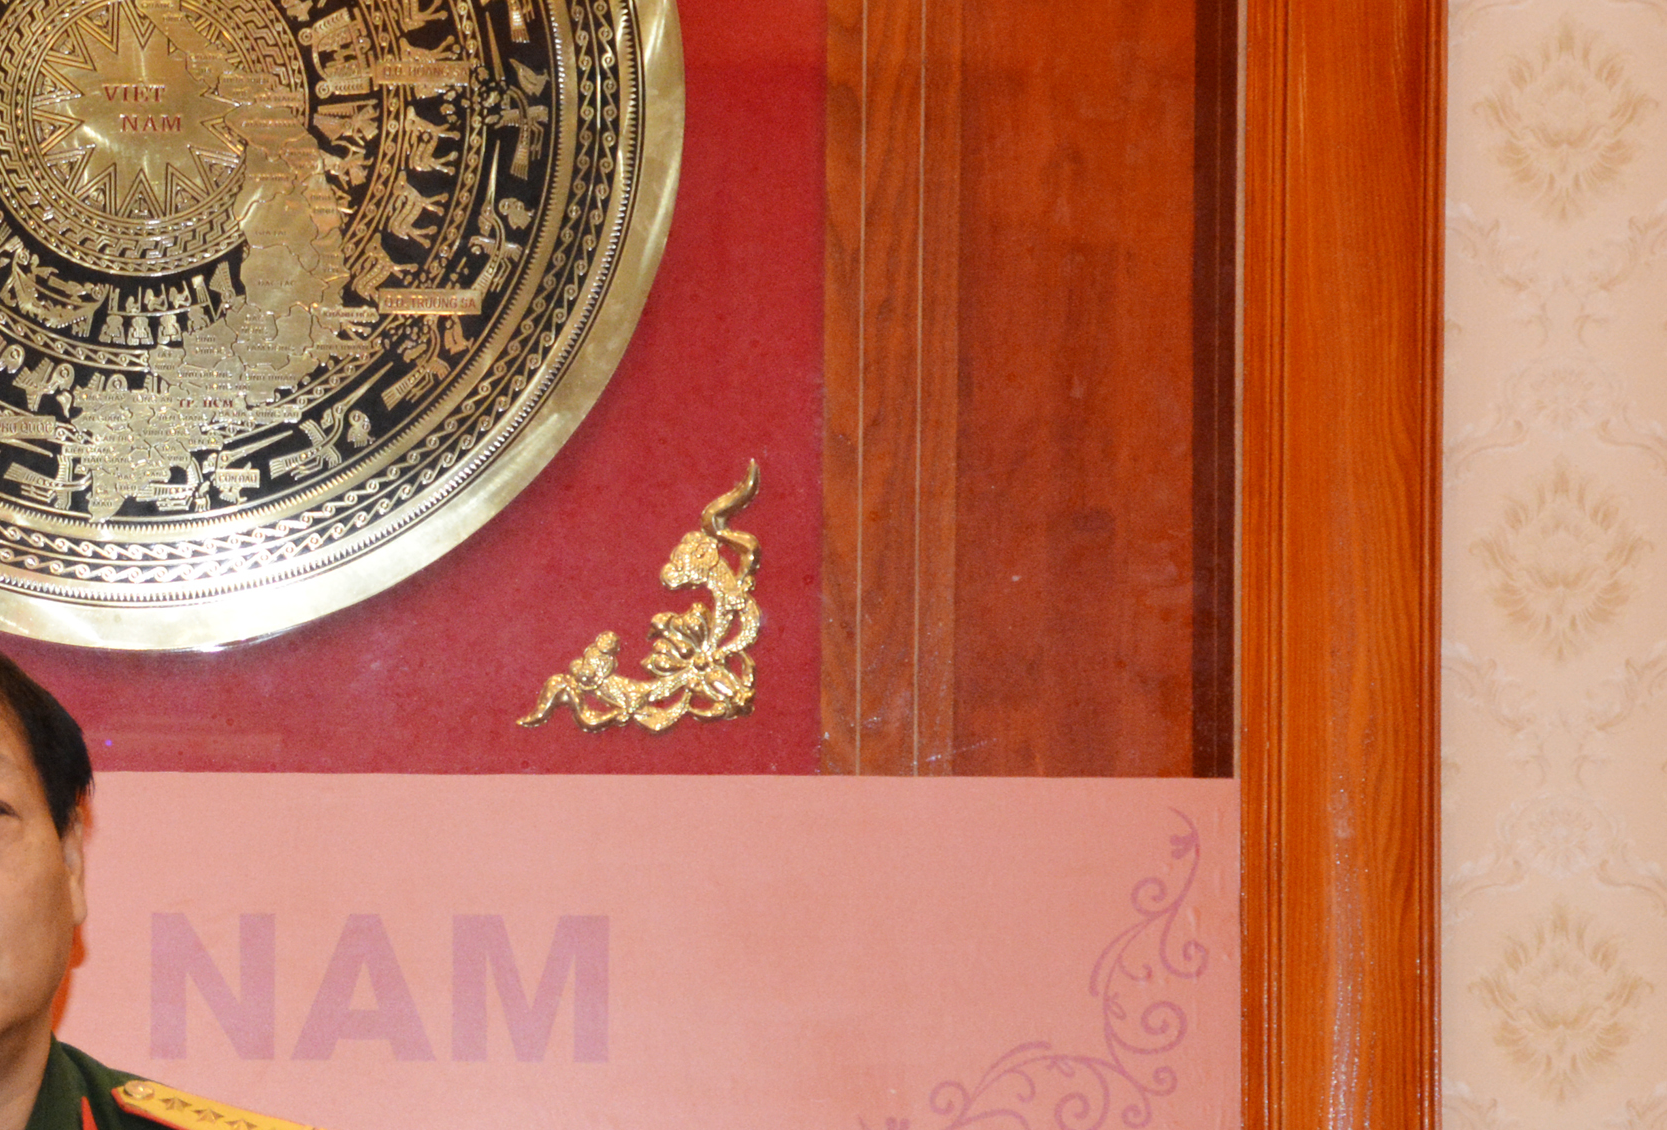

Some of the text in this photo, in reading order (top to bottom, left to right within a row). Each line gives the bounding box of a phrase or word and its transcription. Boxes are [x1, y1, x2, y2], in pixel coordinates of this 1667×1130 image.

[119, 113, 182, 132] NAM
[460, 297, 477, 309] SA
[149, 911, 610, 1063] NAM
